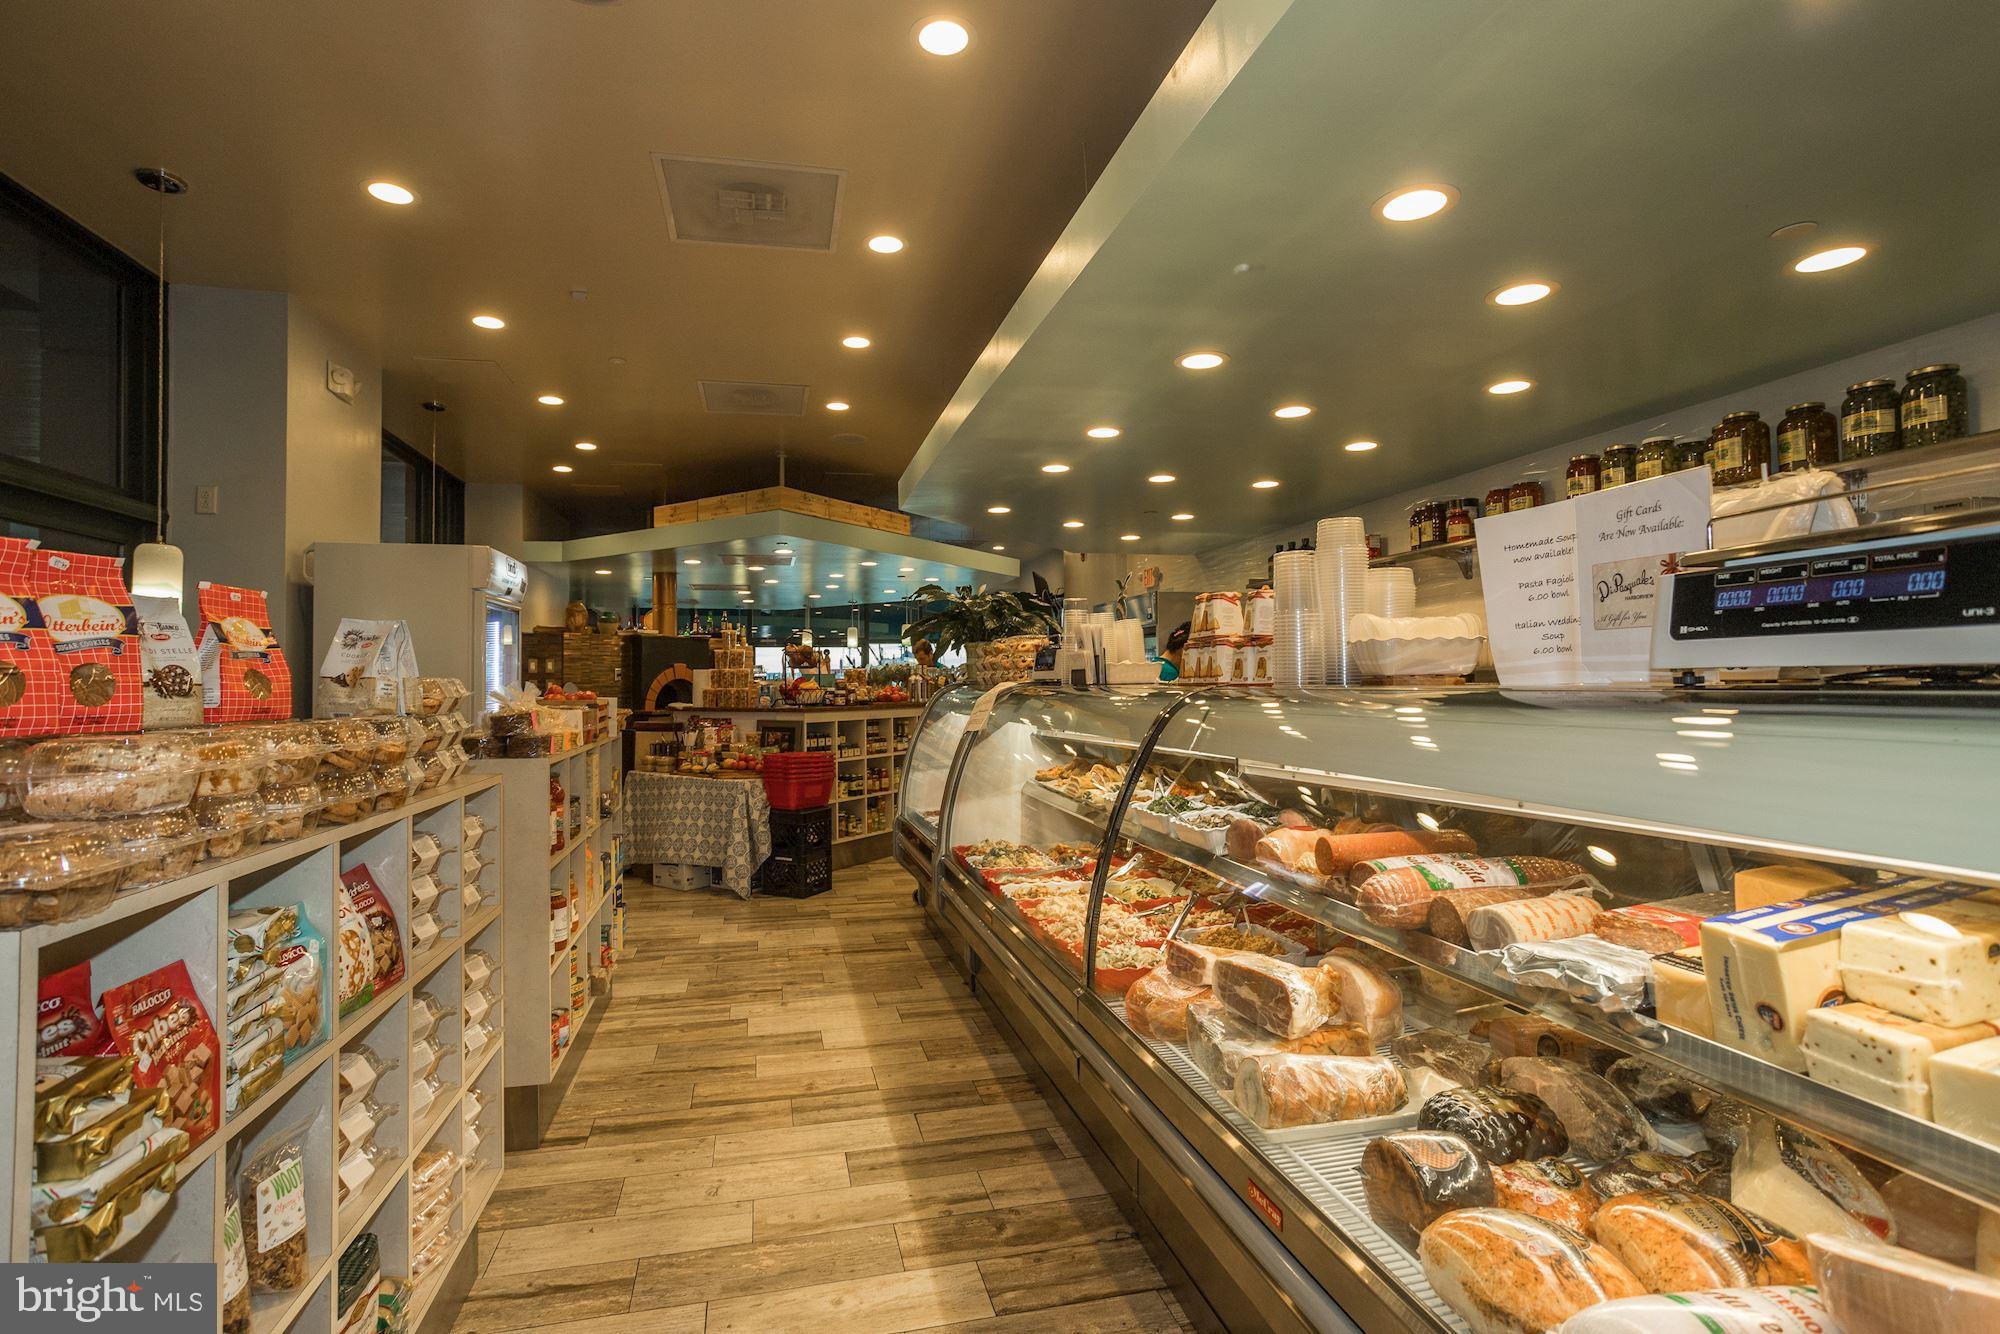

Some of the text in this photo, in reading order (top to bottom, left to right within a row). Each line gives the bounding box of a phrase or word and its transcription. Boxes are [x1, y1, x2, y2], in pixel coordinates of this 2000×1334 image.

[1616, 500, 1663, 523] Gift Cards
[1599, 530, 1615, 542] Are
[1615, 526, 1637, 540] Now
[1504, 537, 1554, 552] Homemade
[1513, 546, 1575, 564] now available!
[1874, 554, 1896, 562] TOTAL
[1897, 551, 1920, 560] PRICE
[1814, 561, 1829, 569] UNIT
[1829, 559, 1849, 567] PRICE
[1518, 572, 1575, 590] Pasta Fagioli
[1528, 589, 1570, 602] 6.00 bowl
[42, 614, 127, 632] Otterbein's
[1515, 620, 1545, 630] Italian
[1631, 612, 1648, 625] You
[1541, 632, 1565, 642] Soup
[55, 639, 111, 651] SUGAR COOKIES
[1533, 644, 1573, 655] 6.00 bowl
[132, 988, 171, 1016] BALOCCO
[133, 1006, 191, 1057] Cubes
